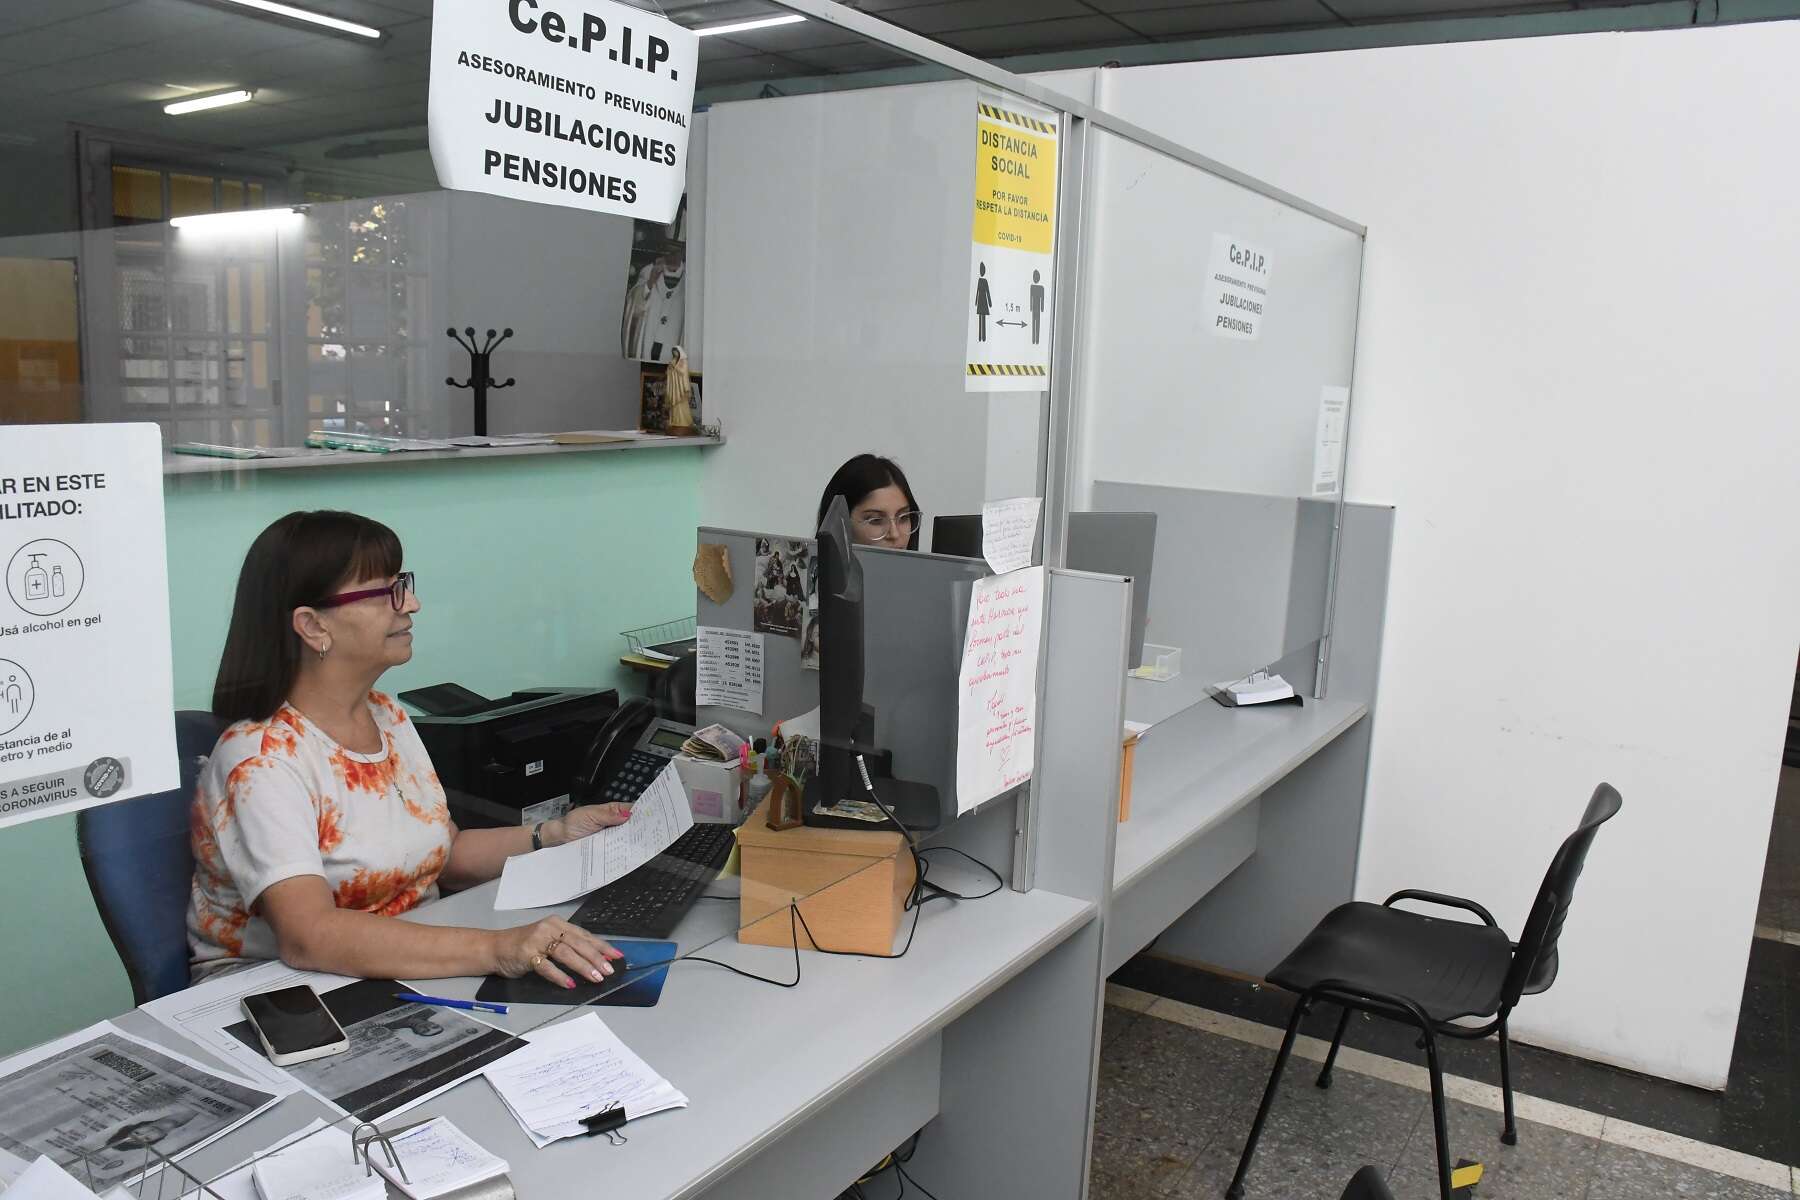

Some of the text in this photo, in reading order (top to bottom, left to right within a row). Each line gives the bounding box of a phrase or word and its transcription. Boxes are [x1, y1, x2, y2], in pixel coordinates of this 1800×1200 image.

[508, 0, 678, 81] Ce.P.I.P.
[457, 51, 687, 128] ASESORAMIENTO PREVISIONAL
[485, 99, 676, 167] JUBILACIONES
[981, 129, 1038, 159] DISTANCIA
[484, 150, 637, 203] PENSIONES
[991, 156, 1030, 179] SOCIAL
[992, 189, 1028, 206] POR FAVOR
[1003, 207, 1012, 216] LA
[1013, 208, 1049, 223] DISTANCIA
[1229, 243, 1266, 275] Ce.P.I.P.
[1219, 293, 1263, 315] JUBILACIONES
[1216, 315, 1253, 334] PENSIONES
[23, 476, 50, 493] EN
[56, 473, 106, 490] ESTE
[22, 619, 64, 634] alcohol
[67, 618, 81, 627] en
[84, 613, 101, 627] gel
[44, 732, 58, 742] de
[61, 728, 71, 739] al
[27, 749, 33, 760] y
[37, 741, 72, 755] medio
[11, 788, 19, 797] A
[22, 777, 65, 795] SEGUIR
